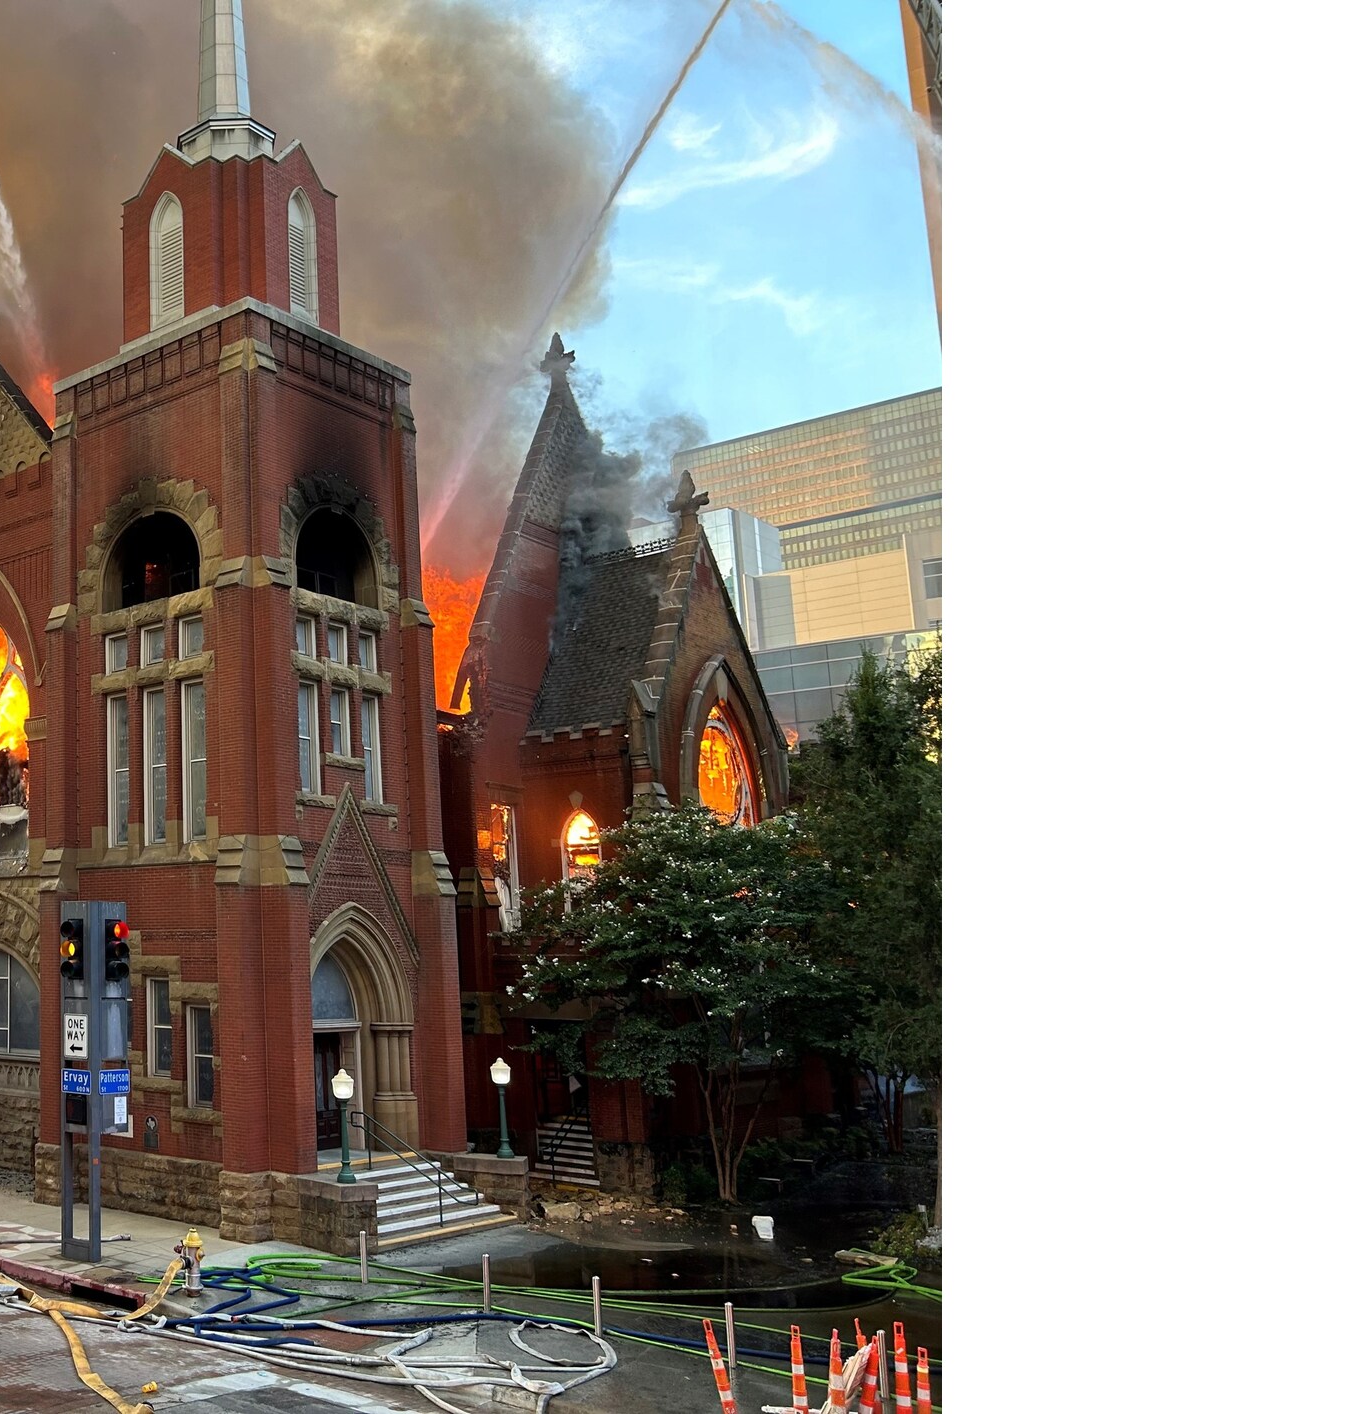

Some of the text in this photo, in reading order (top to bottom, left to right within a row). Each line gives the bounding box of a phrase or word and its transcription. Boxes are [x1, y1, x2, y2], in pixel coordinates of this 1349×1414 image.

[67, 1018, 85, 1030] ONE
[66, 1030, 86, 1041] WAY
[63, 1071, 89, 1086] Ervay
[100, 1072, 129, 1084] Patterson
